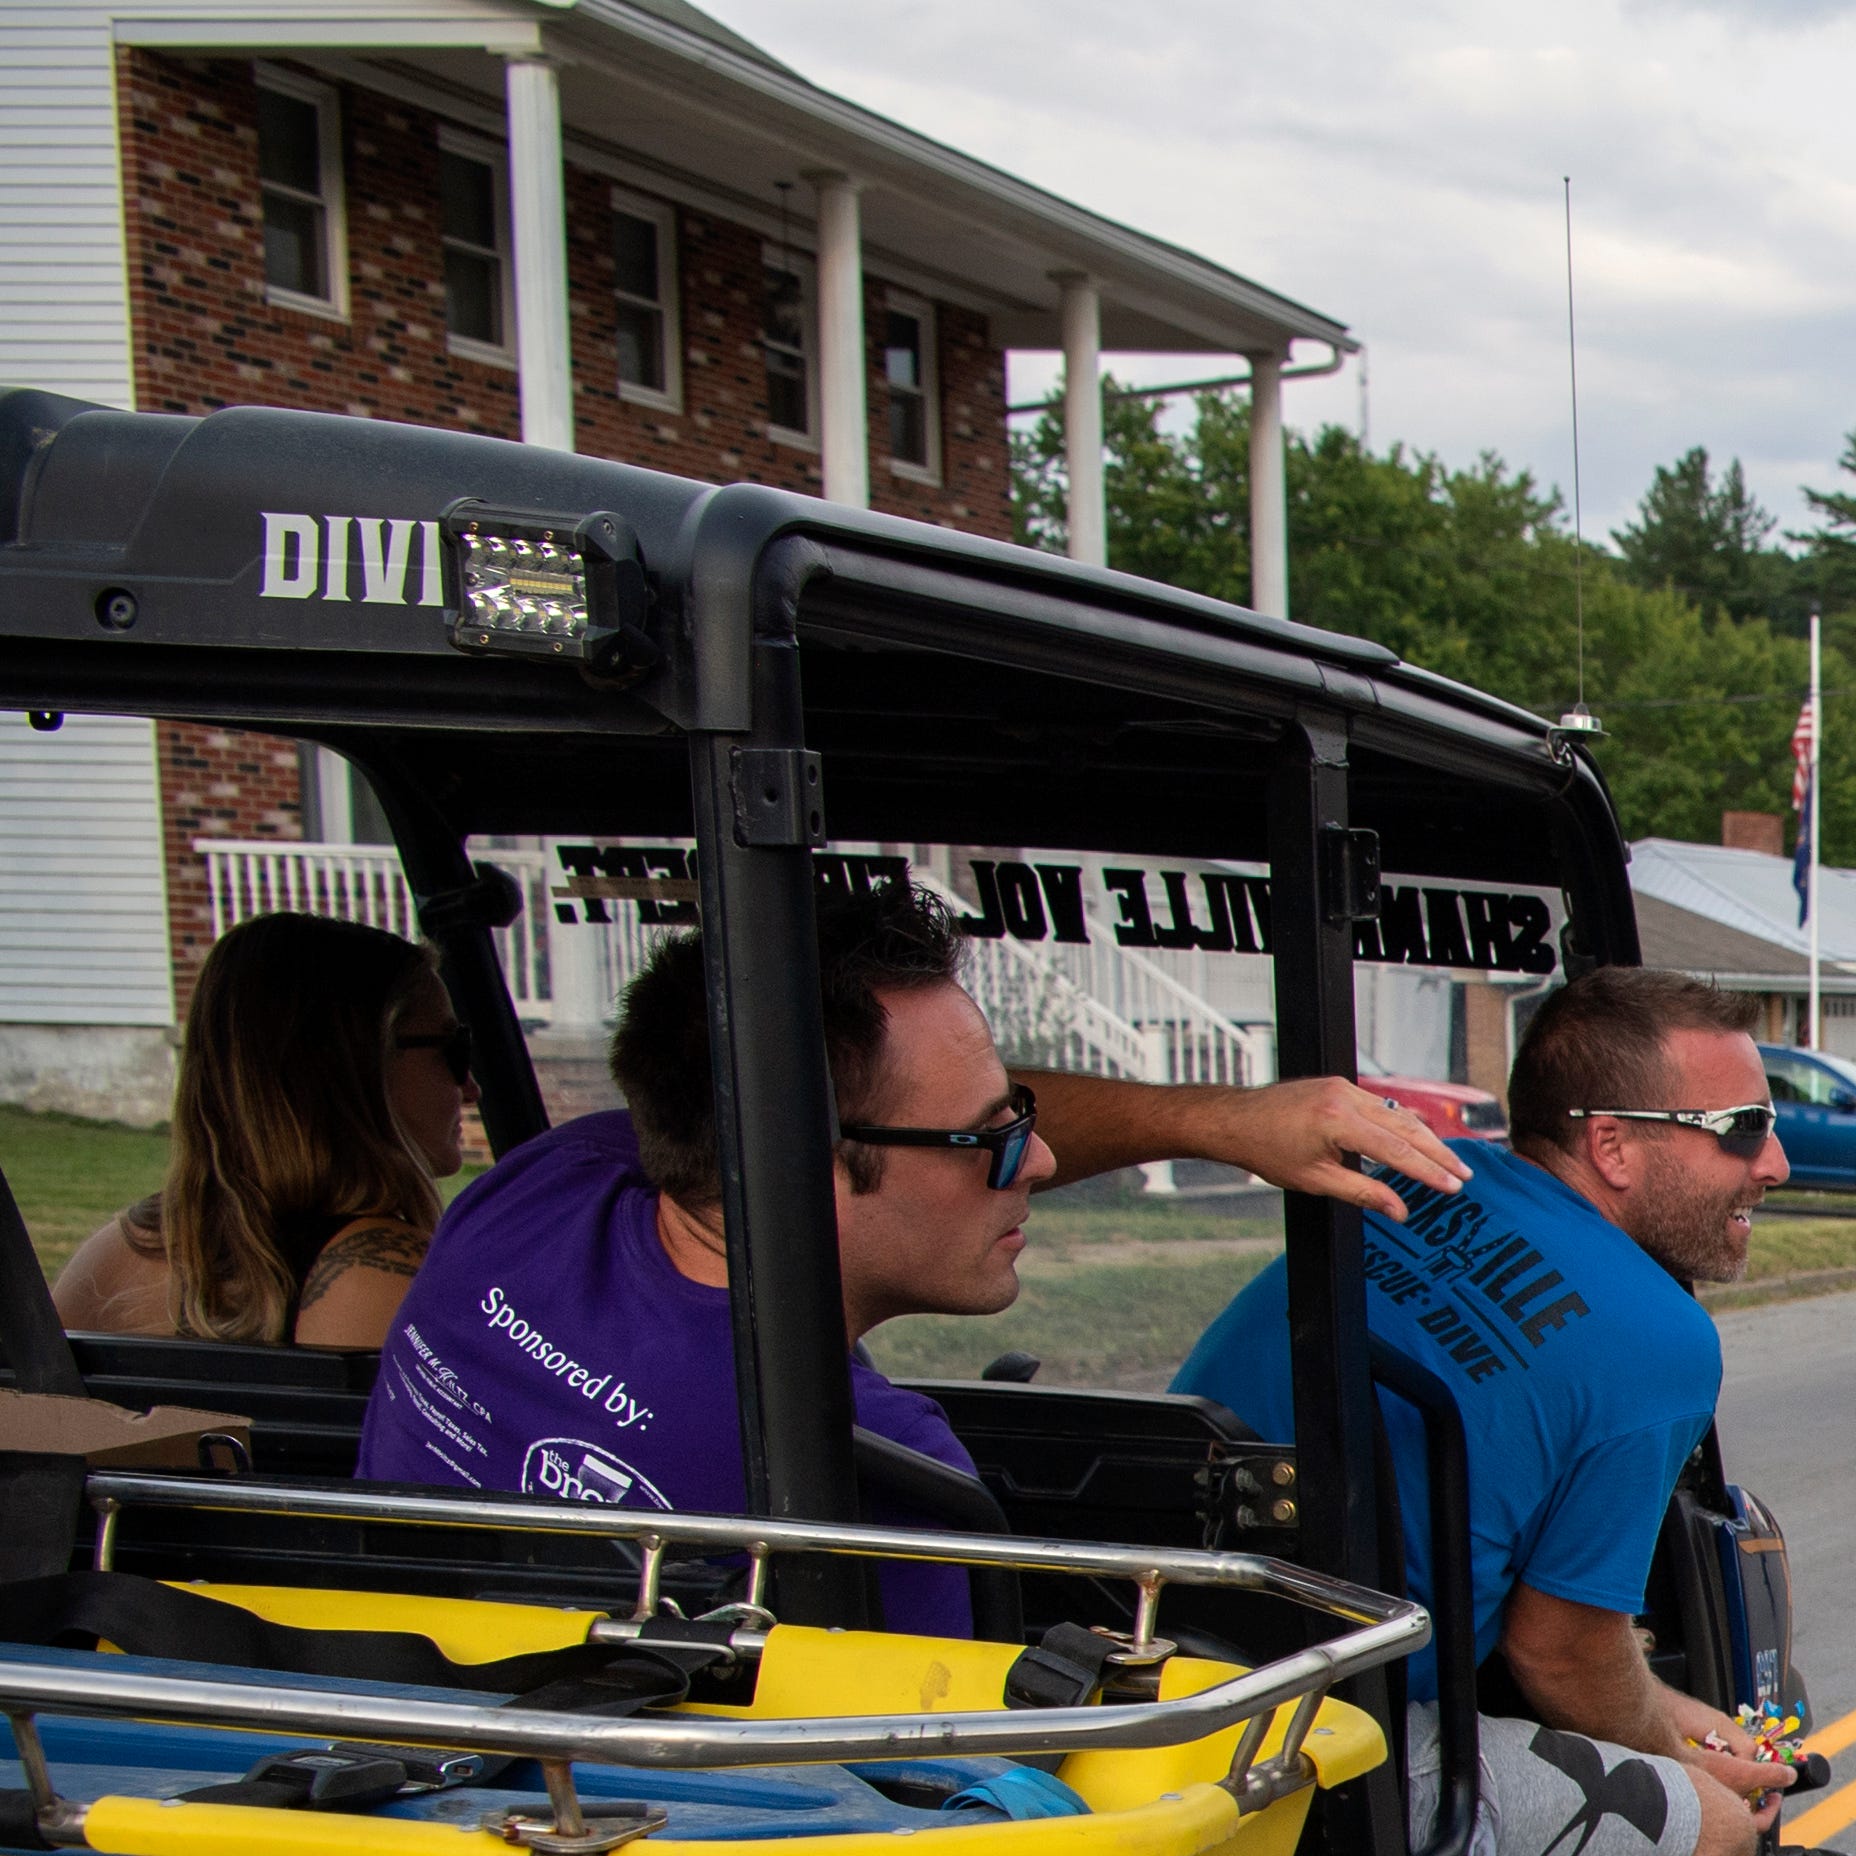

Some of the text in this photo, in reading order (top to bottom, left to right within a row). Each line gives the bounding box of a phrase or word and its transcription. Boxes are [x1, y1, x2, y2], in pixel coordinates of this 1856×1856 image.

[403, 1323, 433, 1361] JENNIFER
[481, 1287, 613, 1400] Sponsored
[604, 1382, 654, 1431] by:
[1416, 1304, 1508, 1385] DIVE
[549, 1450, 570, 1472] the
